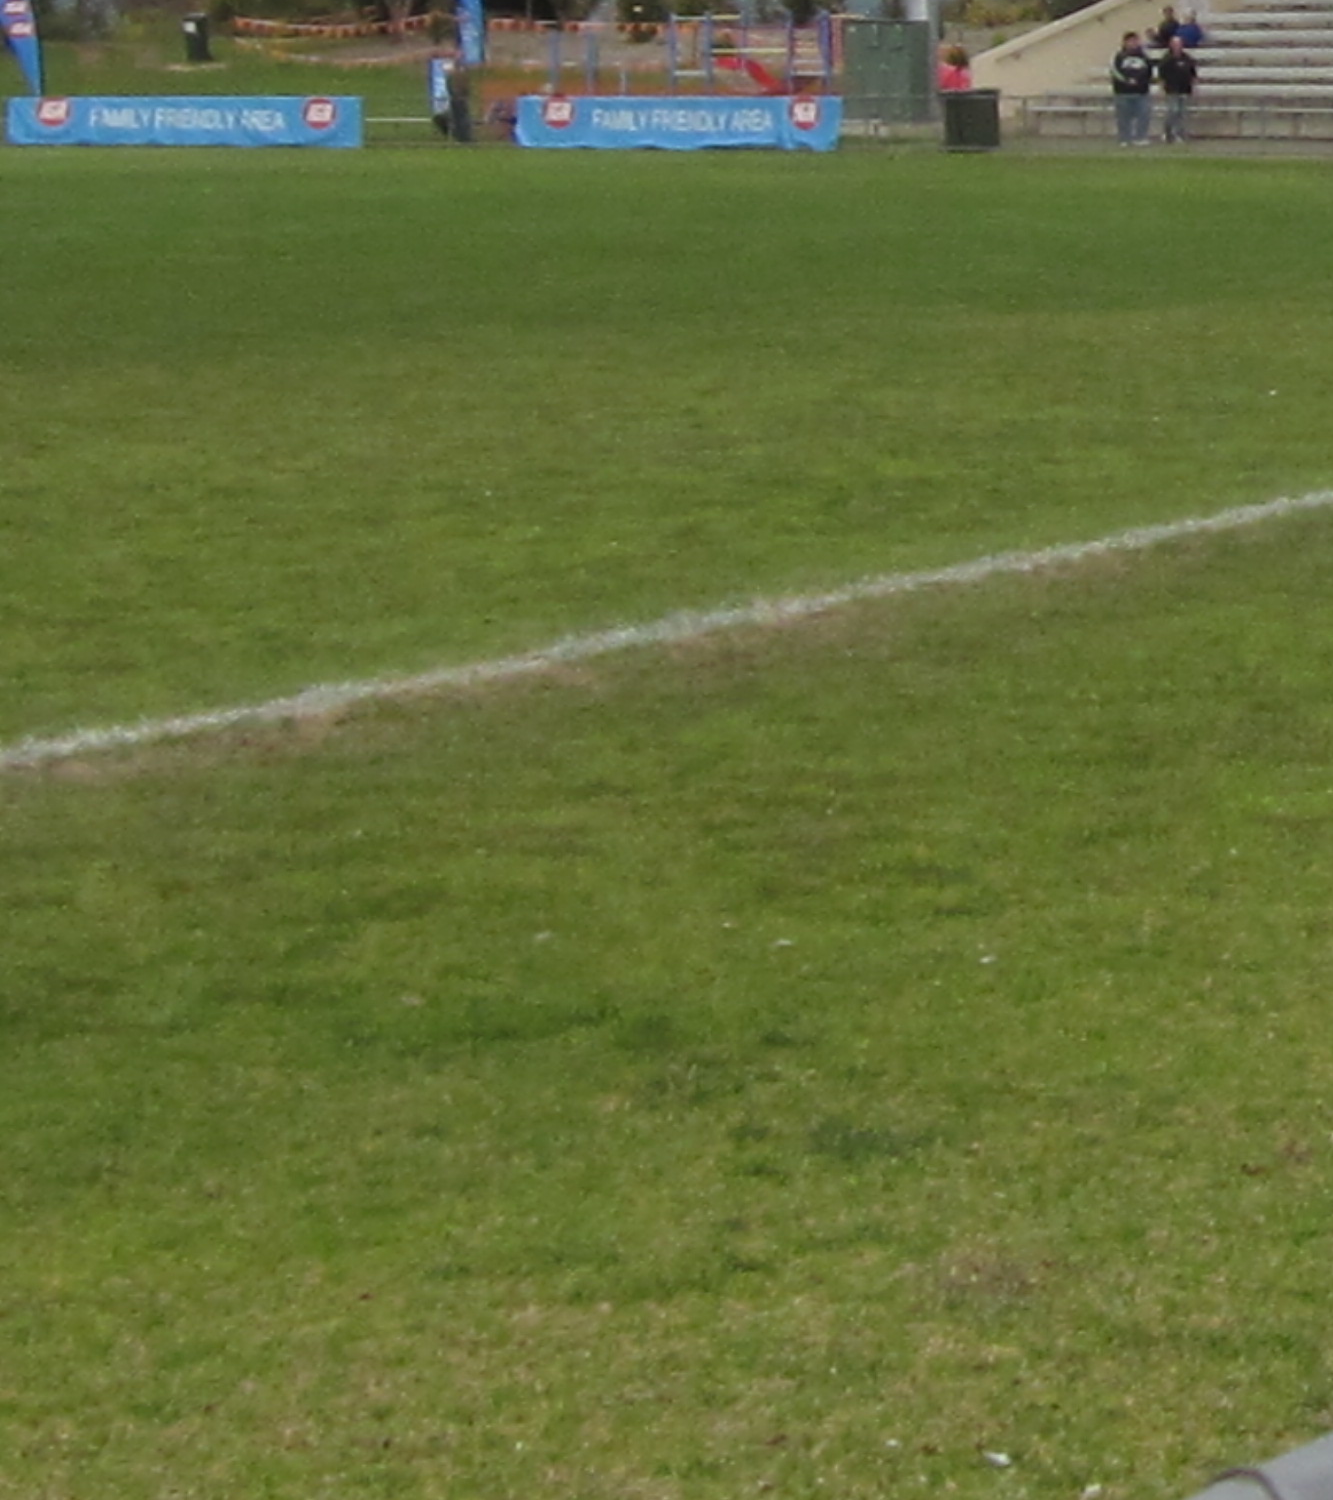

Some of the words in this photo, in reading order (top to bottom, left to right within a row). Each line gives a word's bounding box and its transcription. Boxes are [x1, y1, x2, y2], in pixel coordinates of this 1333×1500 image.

[90, 106, 149, 129] FAMILY
[154, 106, 236, 130] FRIENDLY
[240, 108, 287, 131] AREA
[592, 108, 648, 132] FAMILY
[651, 108, 728, 132] FRIENDLY
[731, 108, 774, 132] AREA
